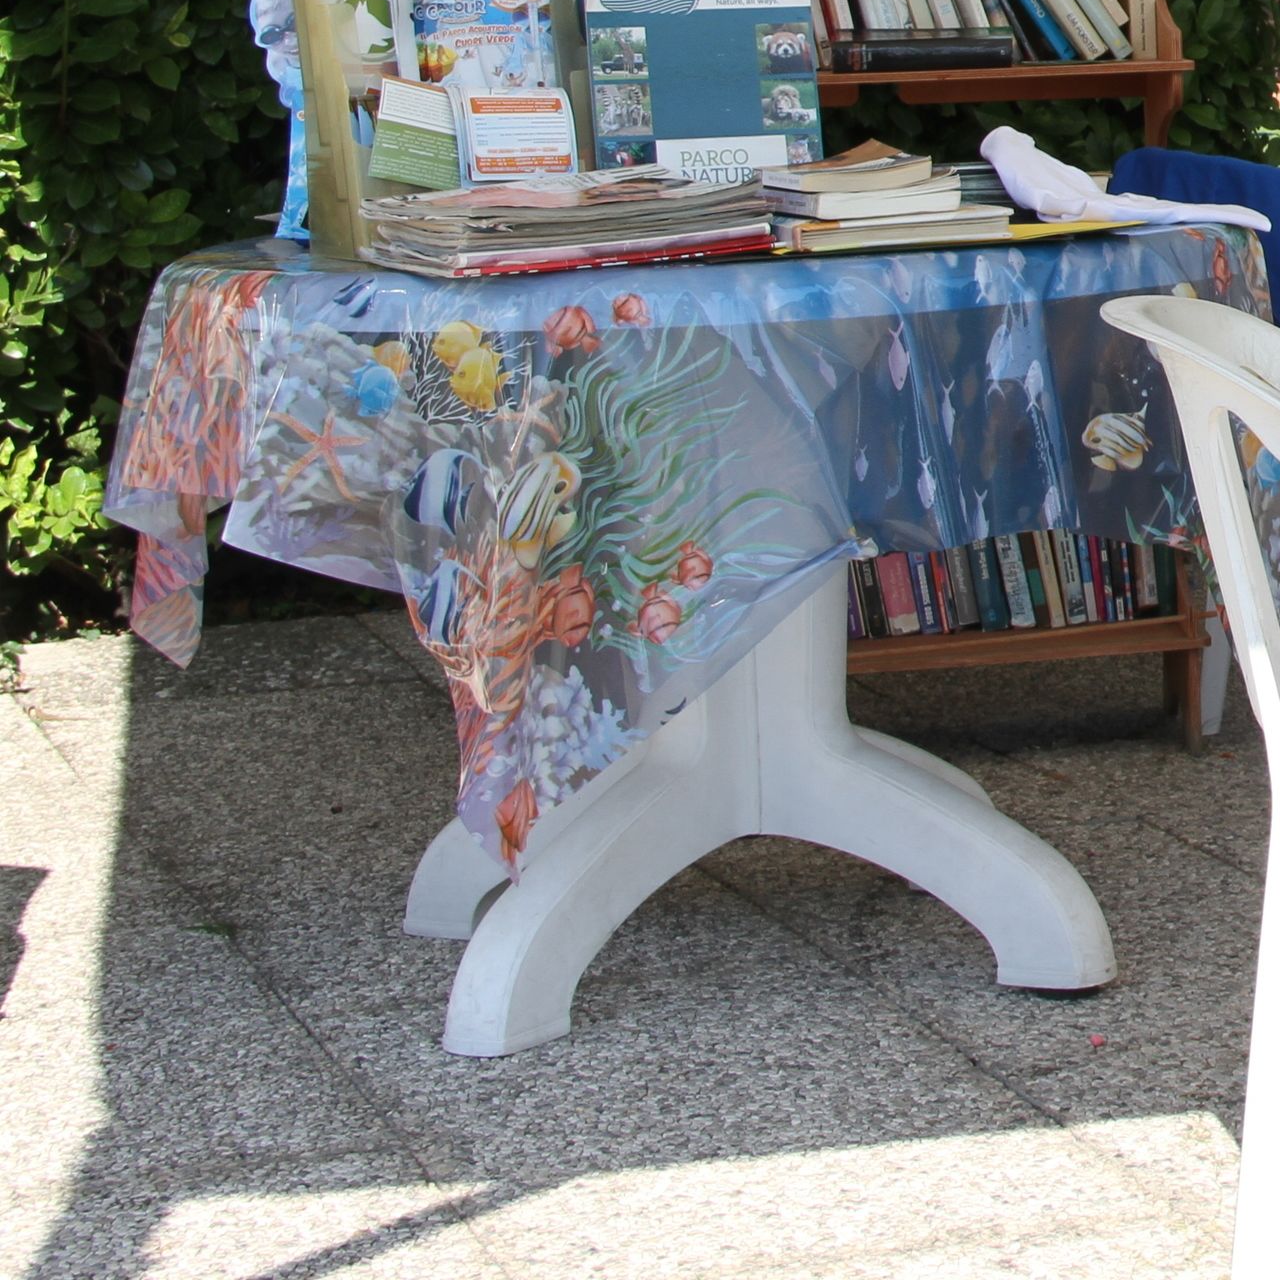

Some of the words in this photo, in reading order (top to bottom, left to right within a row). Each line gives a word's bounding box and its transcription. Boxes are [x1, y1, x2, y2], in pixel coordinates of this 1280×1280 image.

[427, 0, 486, 20] CAVOUR
[442, 27, 467, 39] PARCO
[455, 37, 483, 48] CUORE
[486, 35, 515, 44] VERDE
[1077, 25, 1099, 55] FORSTER
[680, 148, 749, 167] PARCO
[682, 166, 754, 184] NATUR
